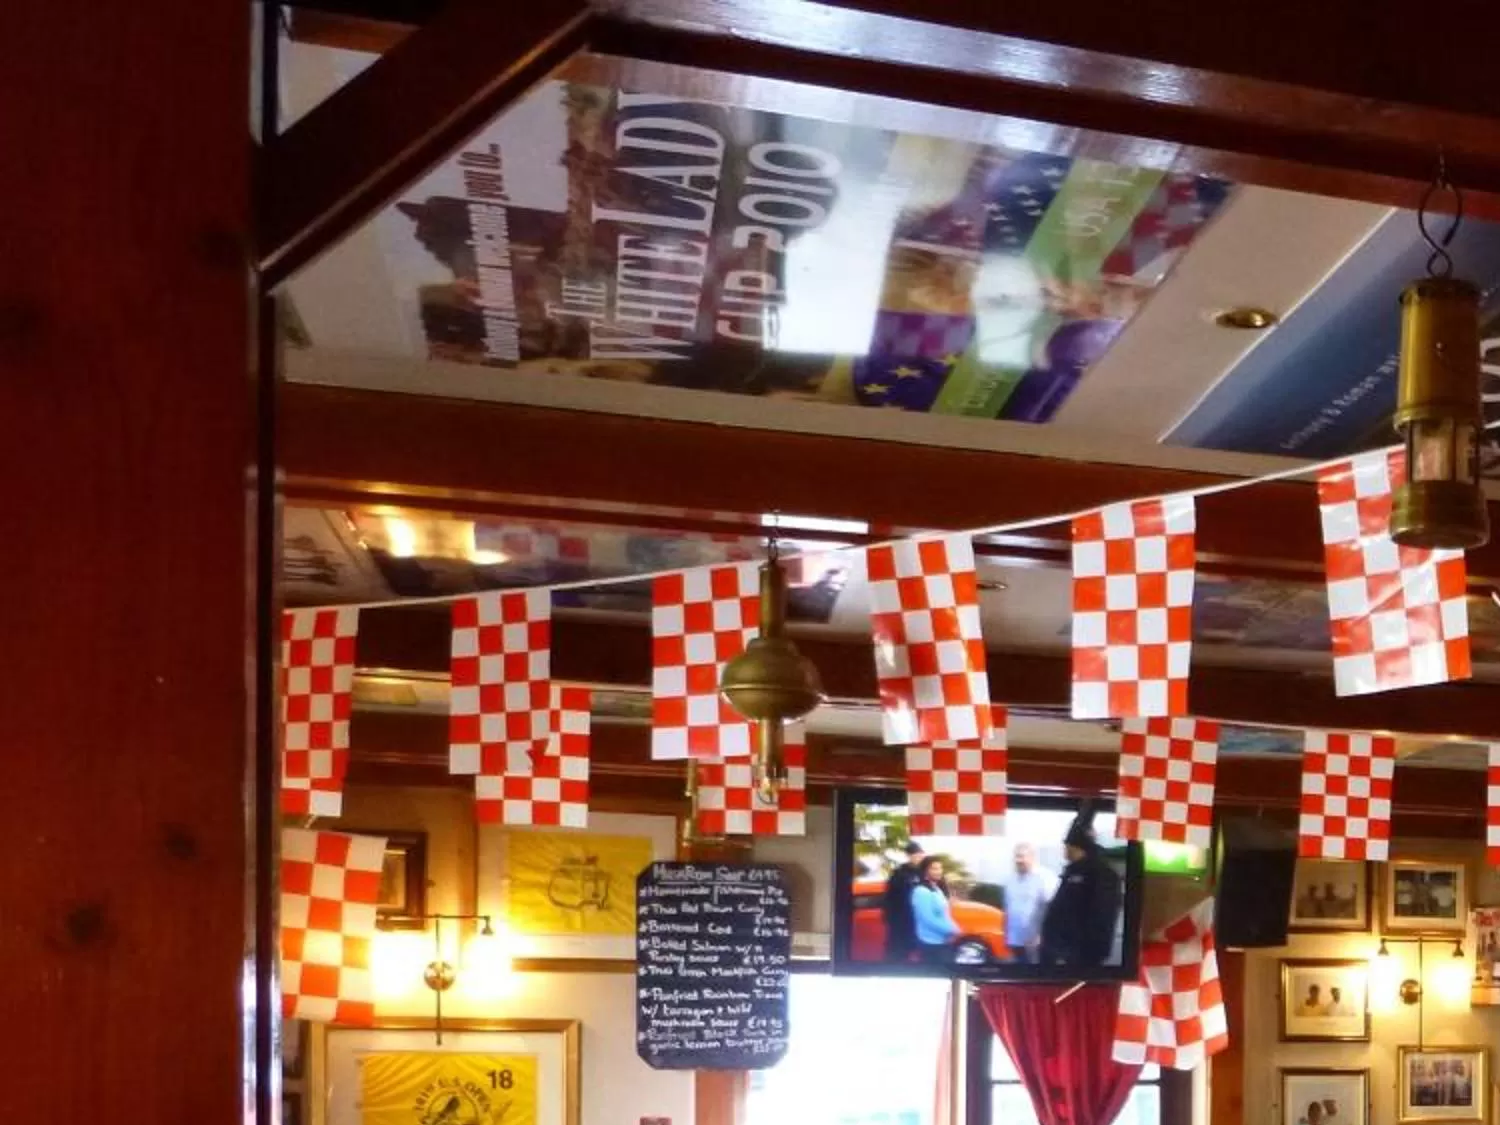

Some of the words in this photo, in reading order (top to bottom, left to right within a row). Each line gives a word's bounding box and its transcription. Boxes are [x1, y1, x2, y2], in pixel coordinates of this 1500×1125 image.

[463, 169, 511, 201] you
[545, 275, 606, 318] THE
[589, 234, 709, 361] WHITE
[486, 1068, 514, 1091] 18
